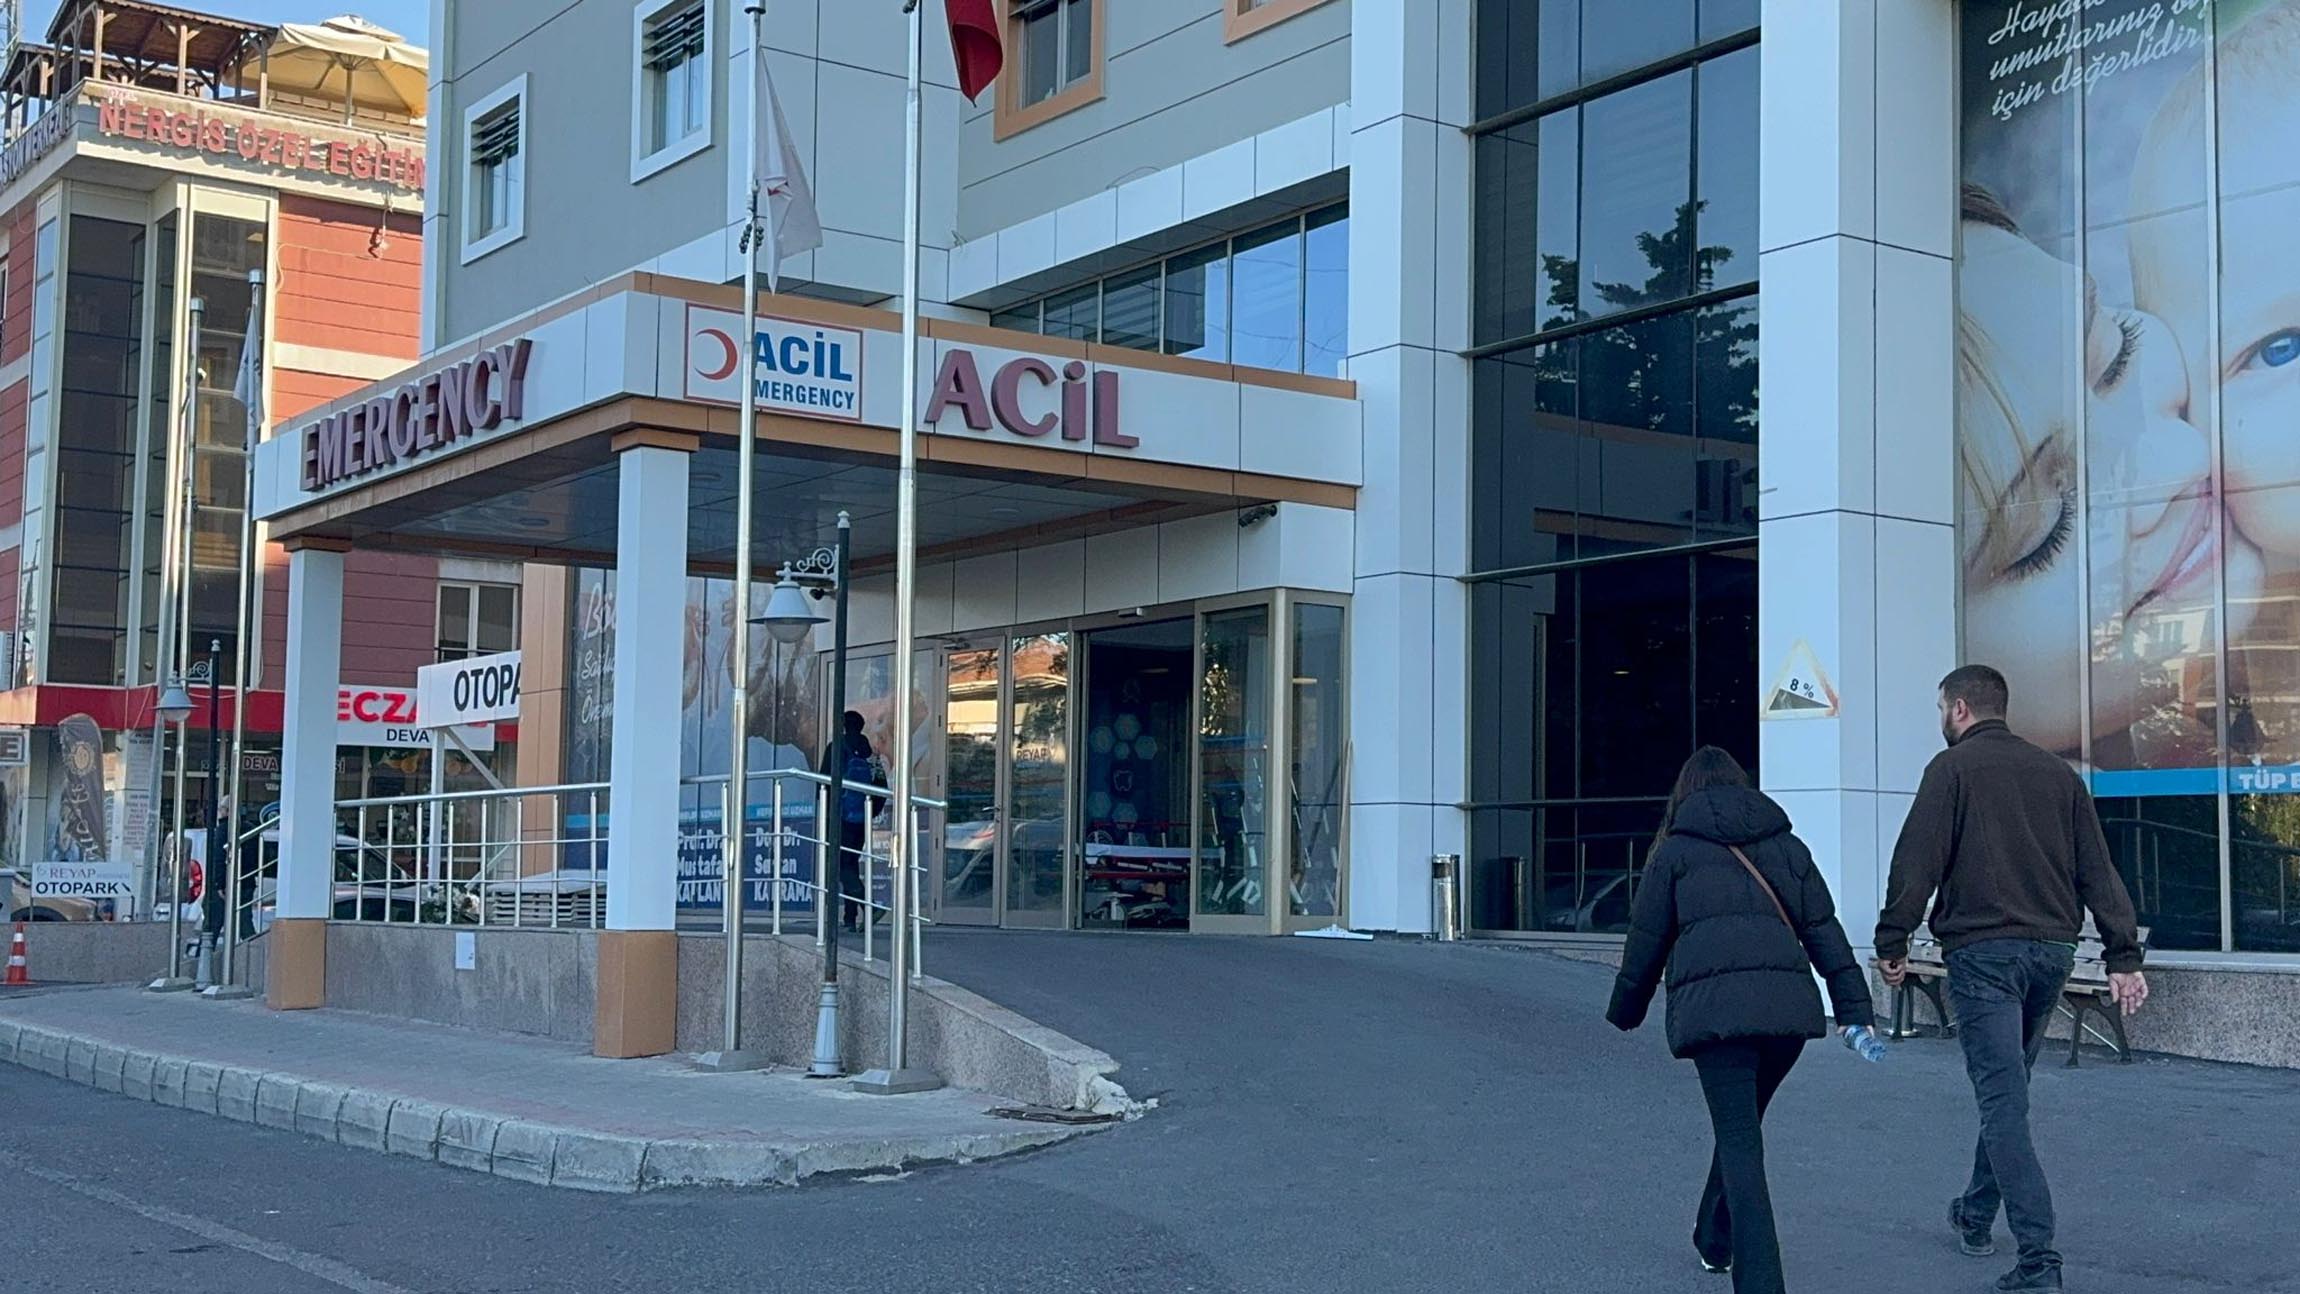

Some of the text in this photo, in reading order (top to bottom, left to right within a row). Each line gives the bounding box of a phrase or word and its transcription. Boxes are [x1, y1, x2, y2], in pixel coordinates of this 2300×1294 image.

[1988, 0, 2105, 44] Haya
[1992, 79, 2045, 121] için
[99, 99, 226, 153] NERGİS
[237, 118, 321, 170] ÖZEL
[754, 331, 853, 382] ACİL
[754, 379, 855, 410] MERGENCY
[300, 338, 533, 491] EMERGENCY
[1790, 678, 1814, 699] 8 %
[386, 728, 430, 743] DEVA
[243, 755, 279, 771] DEVA
[2239, 769, 2286, 790] TÜP
[784, 826, 800, 846] Dr.
[50, 868, 96, 879] REYAP
[36, 881, 119, 895] OTOPARK
